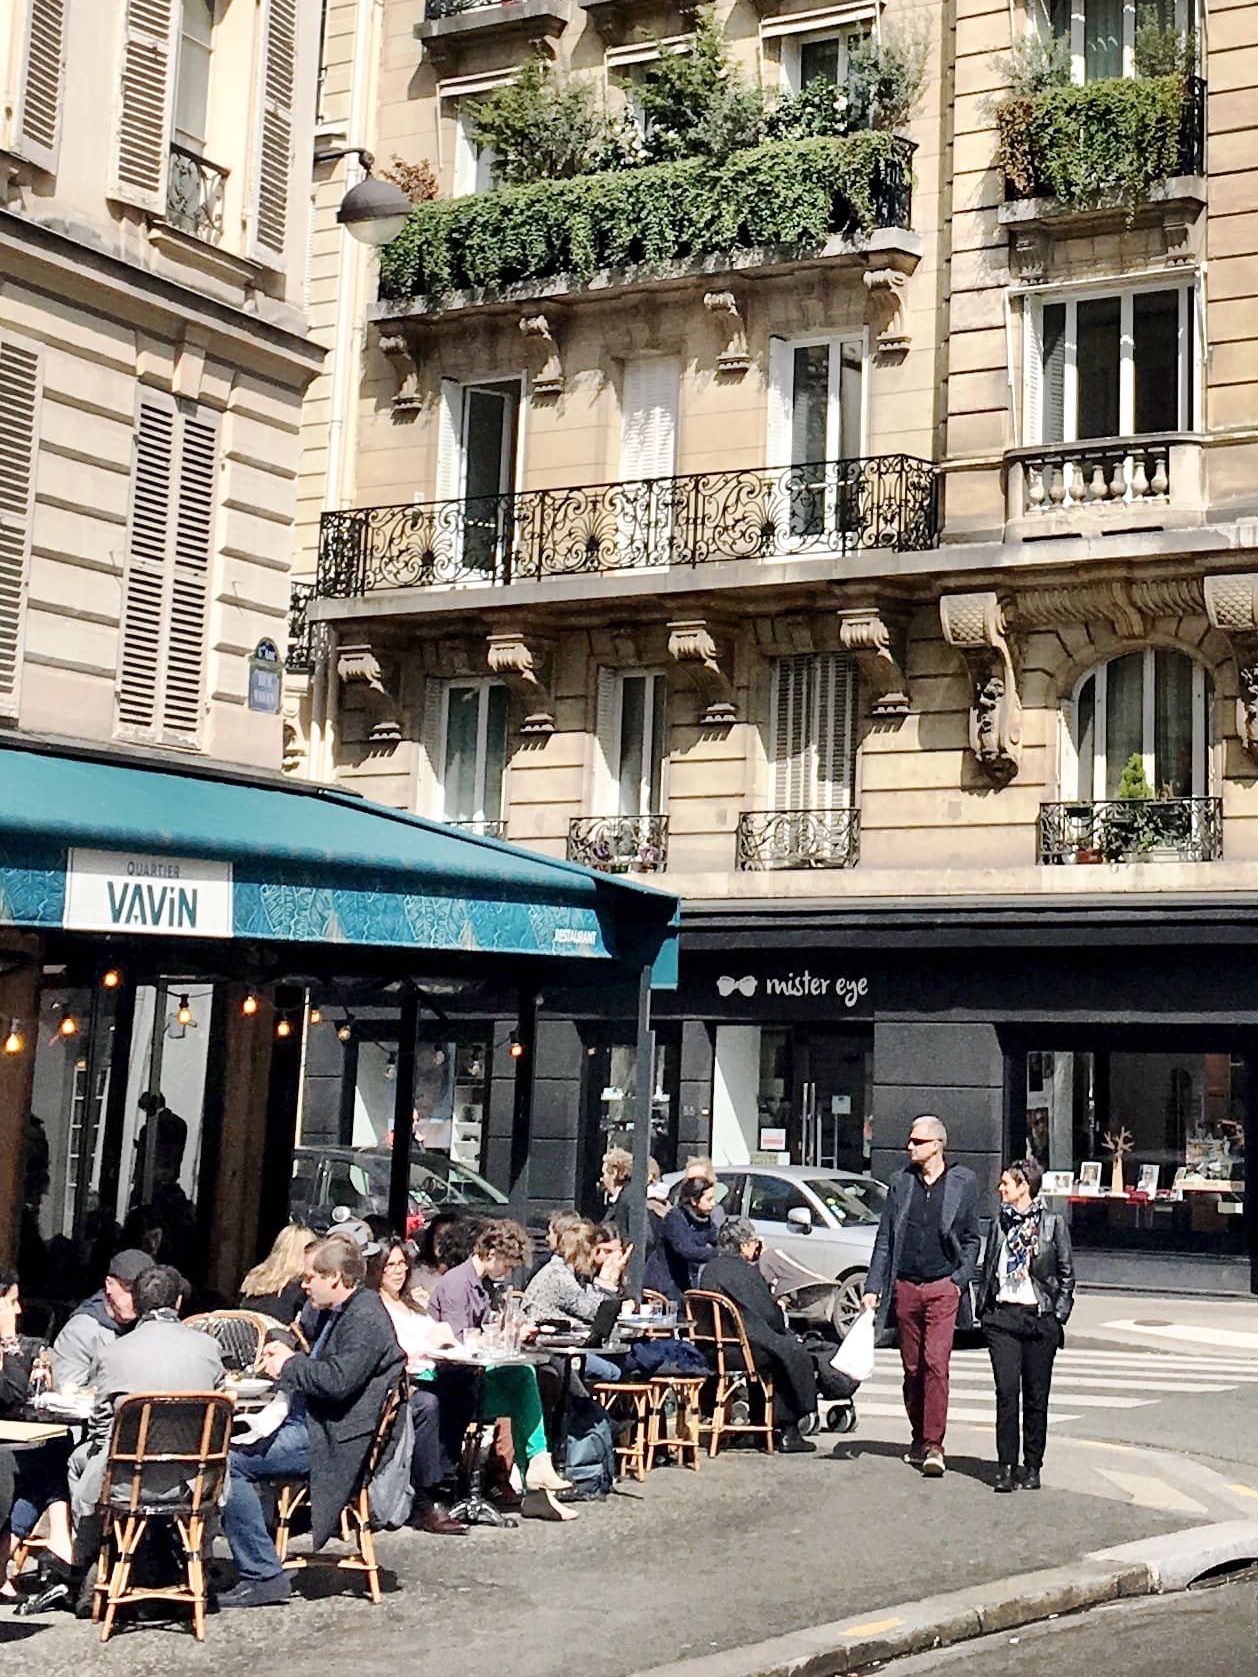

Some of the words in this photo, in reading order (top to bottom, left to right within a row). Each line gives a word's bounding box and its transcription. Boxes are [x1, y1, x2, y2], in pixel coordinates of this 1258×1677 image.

[127, 861, 181, 878] QUARTIER
[553, 928, 598, 945] RESTAURANT
[766, 970, 831, 996] mister
[835, 977, 869, 1008] eye
